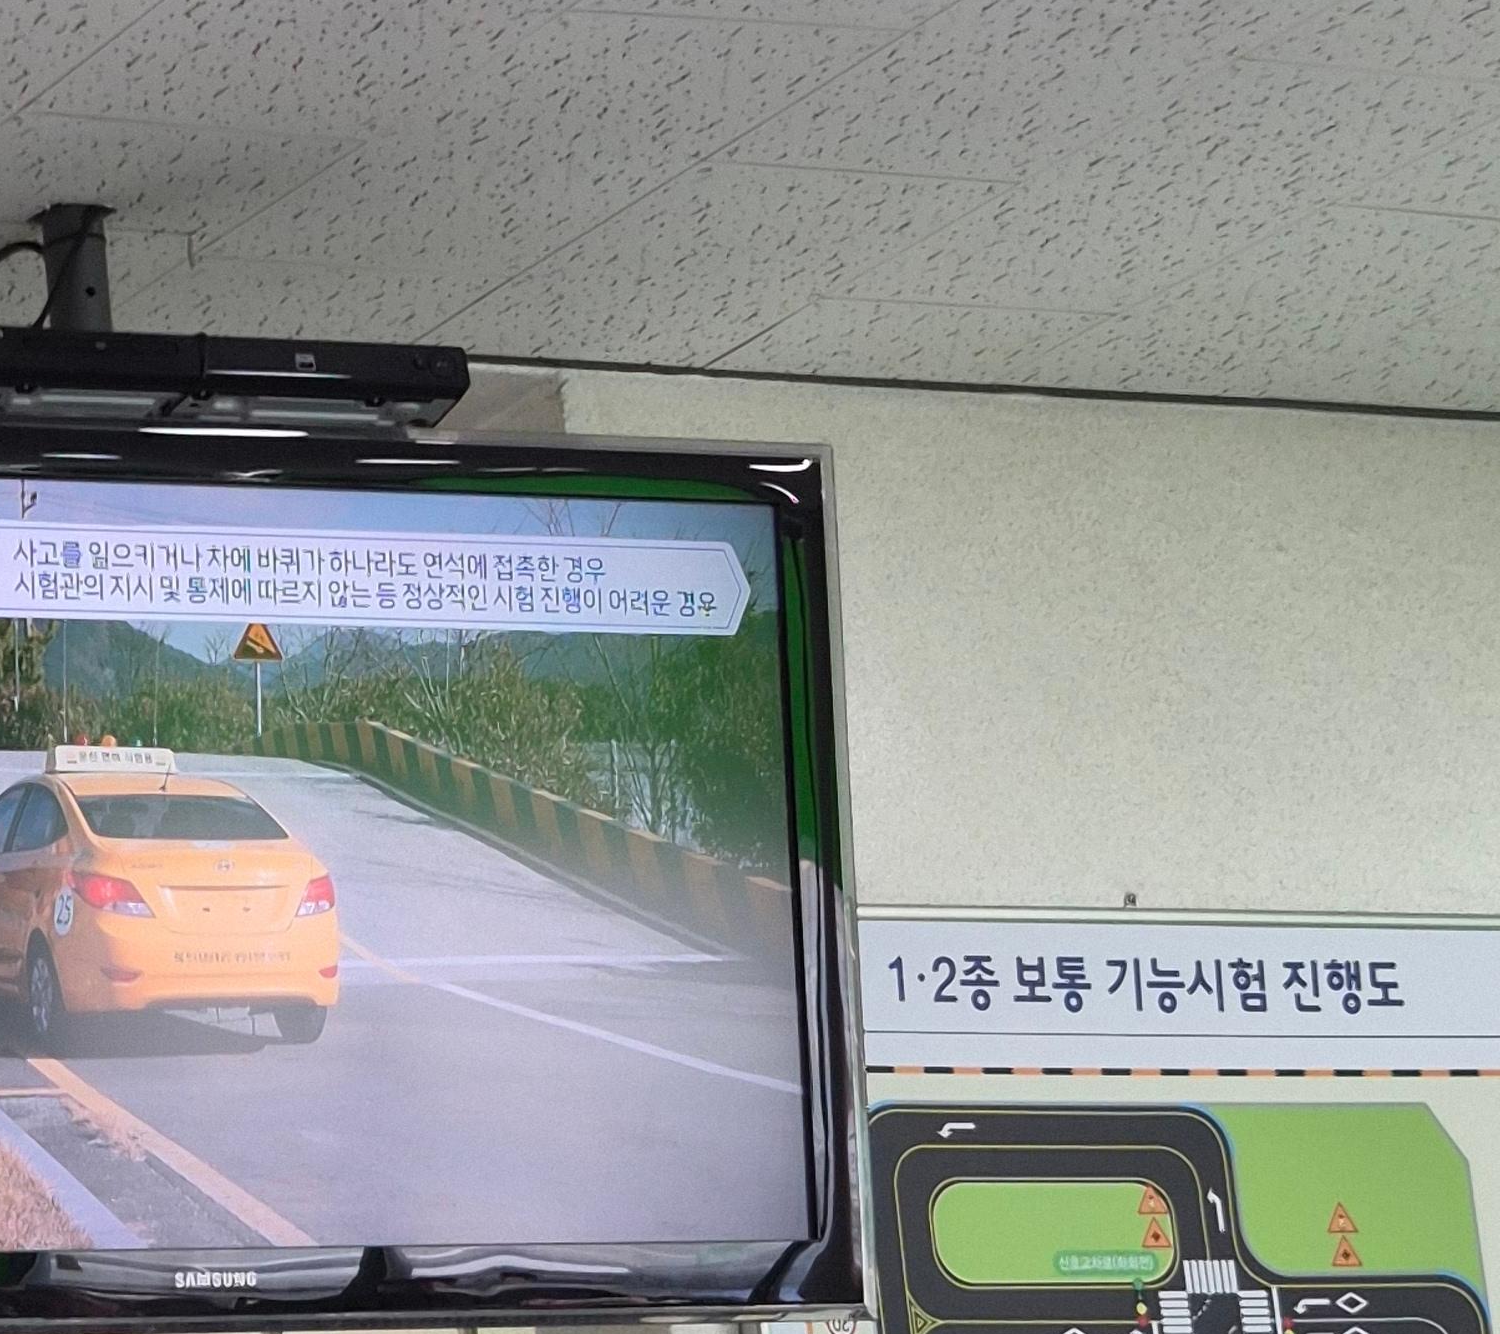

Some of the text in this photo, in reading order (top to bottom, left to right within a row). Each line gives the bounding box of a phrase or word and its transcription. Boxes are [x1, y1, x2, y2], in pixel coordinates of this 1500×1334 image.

[13, 539, 82, 569] 사고를
[206, 543, 250, 574] 차에
[257, 547, 325, 576] 바퀴가
[328, 549, 417, 579] 하나라도
[423, 552, 488, 581] 연석에
[492, 554, 559, 583] 접촉한
[563, 556, 607, 585] 경우
[14, 571, 104, 601] 시험관의
[110, 573, 154, 603] 지시
[160, 574, 181, 604] 및
[186, 575, 251, 606] 통제에
[257, 578, 322, 608] 따르지
[328, 579, 372, 609] 않는
[375, 582, 397, 610] 등
[402, 582, 488, 612] 정상적인
[493, 585, 535, 614] 시험
[539, 586, 602, 615] 진행이
[609, 588, 671, 618] 어려운
[888, 955, 1405, 1015] 1·2종 보통 기능시험 진행도
[174, 1270, 257, 1288] SAMSUNG
